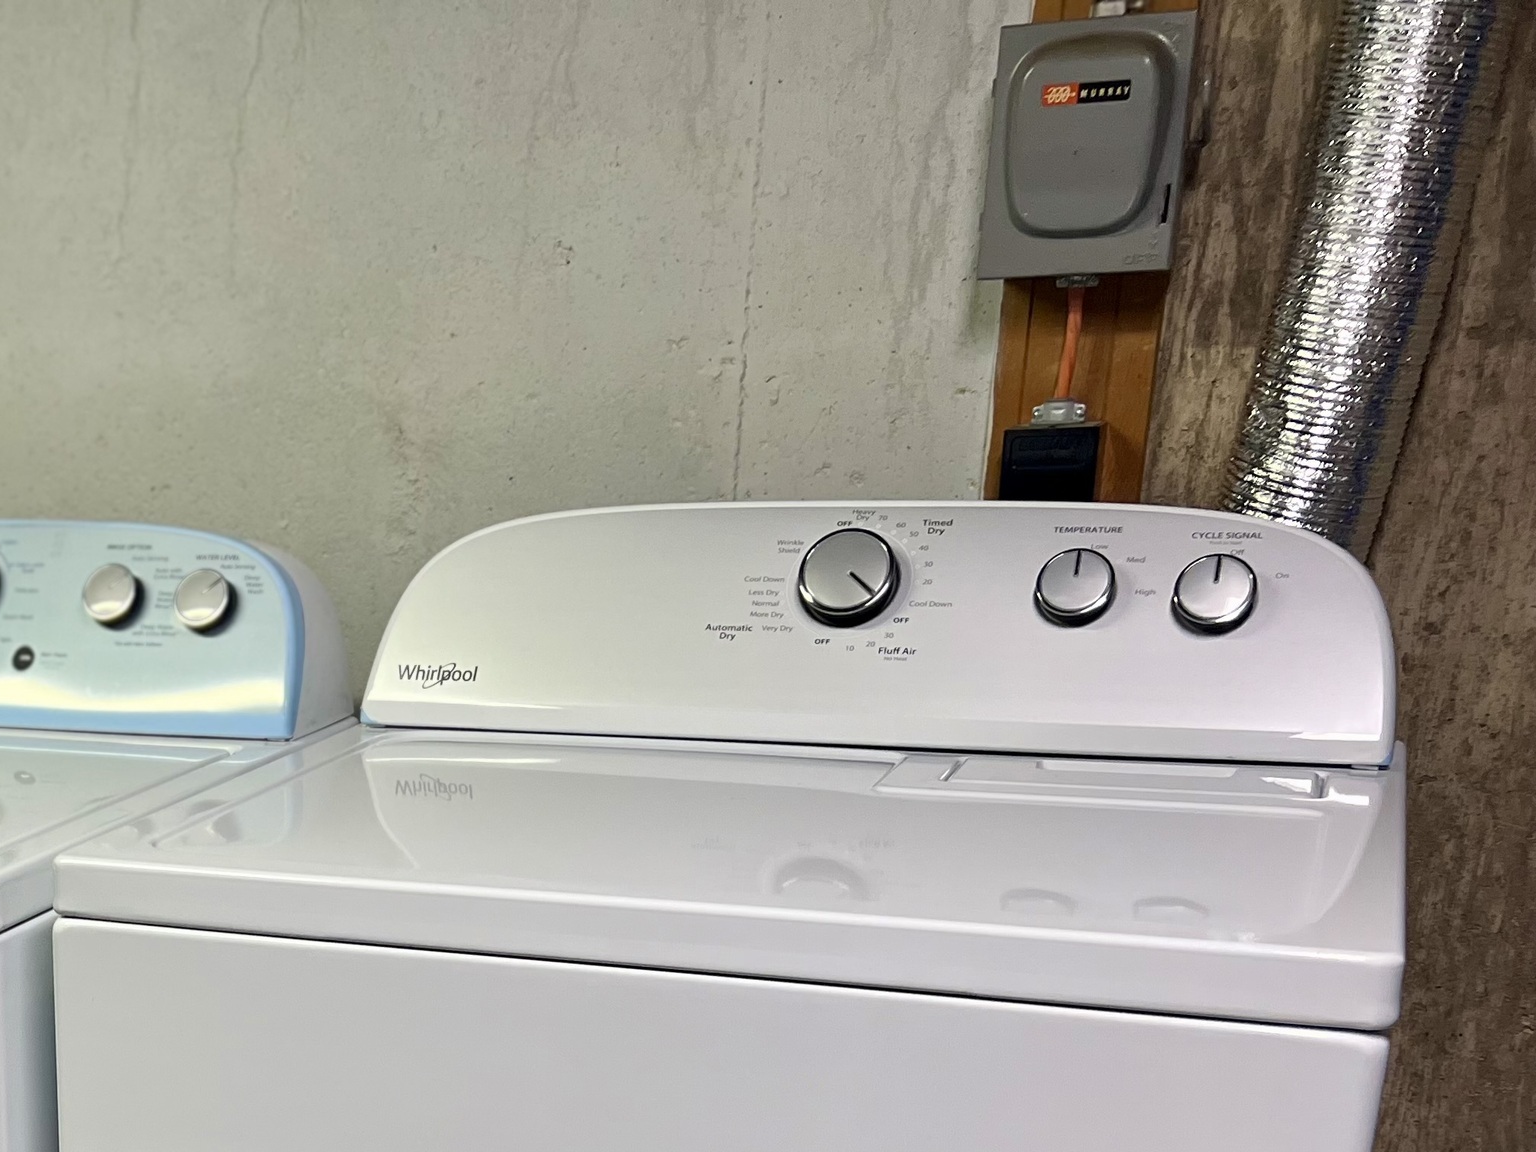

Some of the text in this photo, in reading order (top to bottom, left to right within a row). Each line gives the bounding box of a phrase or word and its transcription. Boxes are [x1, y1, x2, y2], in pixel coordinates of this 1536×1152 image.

[927, 528, 945, 536] Dry
[1054, 526, 1123, 534] TEMPERATURE
[1191, 532, 1223, 540] CYCLE
[705, 624, 753, 632] Automatic
[719, 633, 736, 641] Dry
[398, 663, 478, 689] Whirlpool
